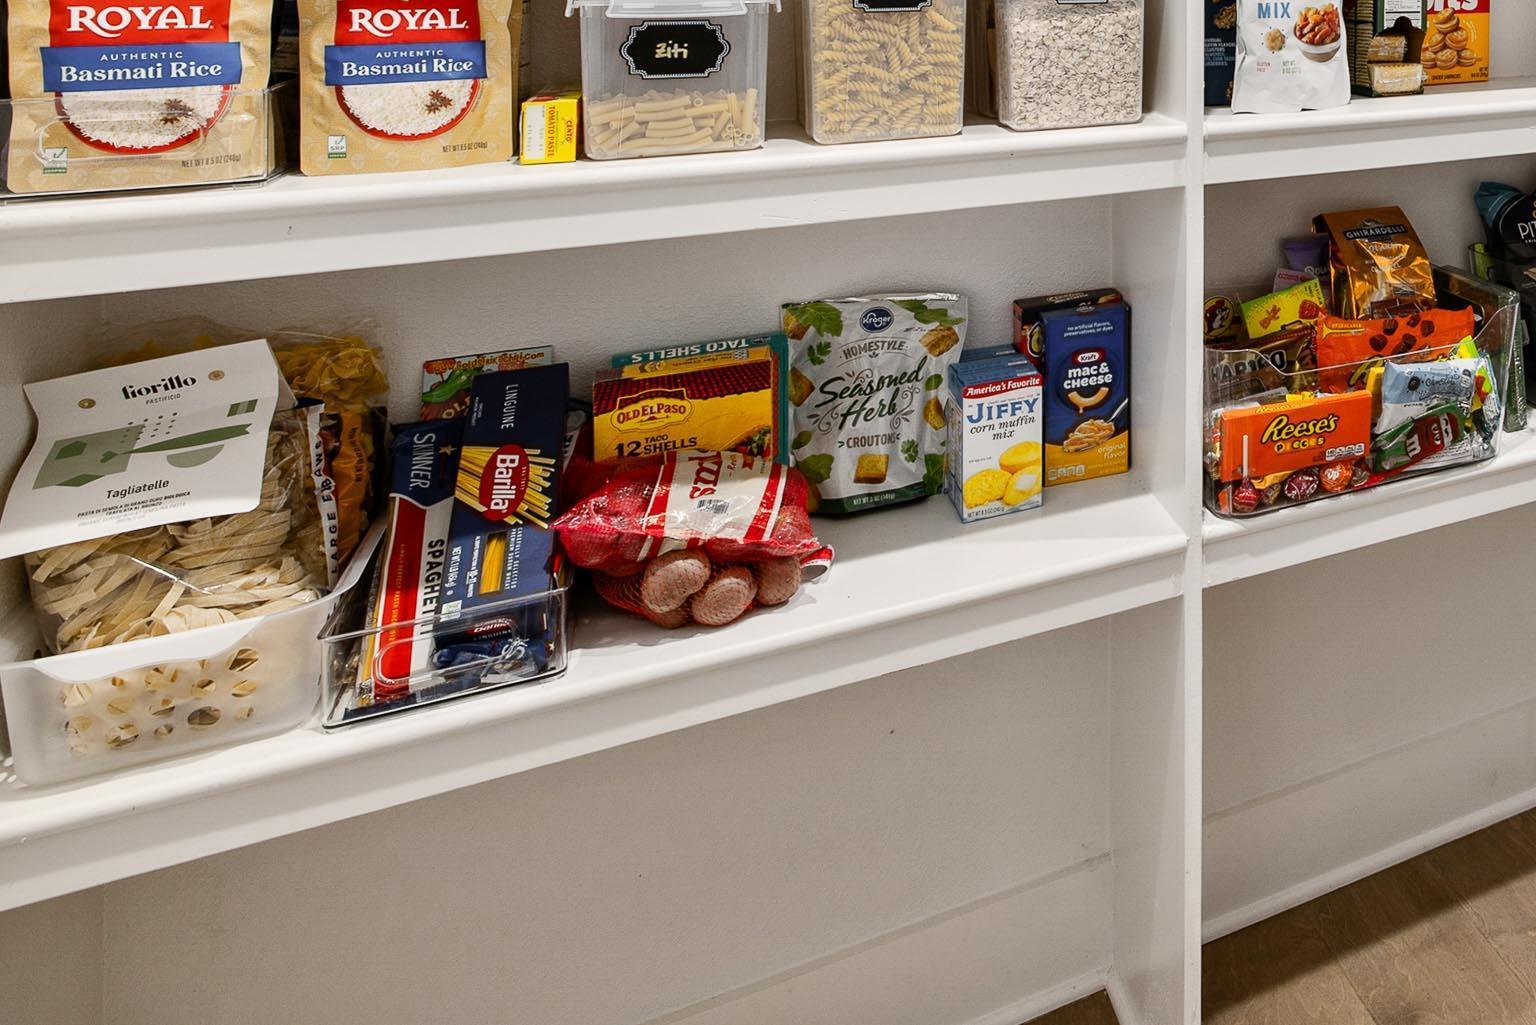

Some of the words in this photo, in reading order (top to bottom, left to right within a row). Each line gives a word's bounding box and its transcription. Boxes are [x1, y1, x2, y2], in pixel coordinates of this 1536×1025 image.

[1258, 2, 1290, 19] MIX
[67, 5, 213, 38] ROYAL
[349, 8, 469, 37] ROYAL
[100, 52, 184, 61] AUTHENTIC
[376, 49, 443, 58] AUTHENTIC
[654, 40, 689, 59] Ziti
[60, 66, 162, 82] Basmati
[171, 63, 222, 78] Rice
[342, 62, 427, 77] Basmati
[433, 59, 473, 72] Rice
[564, 120, 572, 144] CENTO
[1345, 226, 1406, 240] GHIRARDELLI
[863, 313, 892, 326] Kroger
[1064, 329, 1096, 338] preservatives,
[632, 344, 702, 364] SHELLS
[706, 338, 749, 352] TACO
[842, 340, 905, 360] HOMESTYLE
[1068, 365, 1098, 378] mac
[1209, 350, 1287, 385] HARIBO
[120, 374, 196, 401] fiorillo
[815, 356, 927, 408] Seasoned
[967, 383, 1005, 397] America's
[1007, 376, 1041, 390] Favorite
[145, 392, 181, 405] PASTIFICIO
[501, 384, 519, 430] LINGUINE
[616, 409, 640, 424] OLD
[835, 397, 899, 431] Herb
[967, 398, 1040, 424] JIFFY
[970, 421, 995, 435] corn
[998, 415, 1035, 430] muffin
[1262, 413, 1339, 444] Reese's
[644, 434, 668, 444] TACO
[846, 433, 896, 449] CROUTONS
[991, 429, 1015, 441] mix
[643, 437, 697, 455] SHELLS
[1098, 443, 1126, 453] original
[1104, 451, 1125, 459] flavor
[409, 433, 436, 490] SKINNER
[107, 480, 169, 499] Tagliatelle
[491, 454, 519, 511] Barilla
[102, 504, 122, 512] SEMOLA
[164, 491, 191, 500] BIOLOGICA
